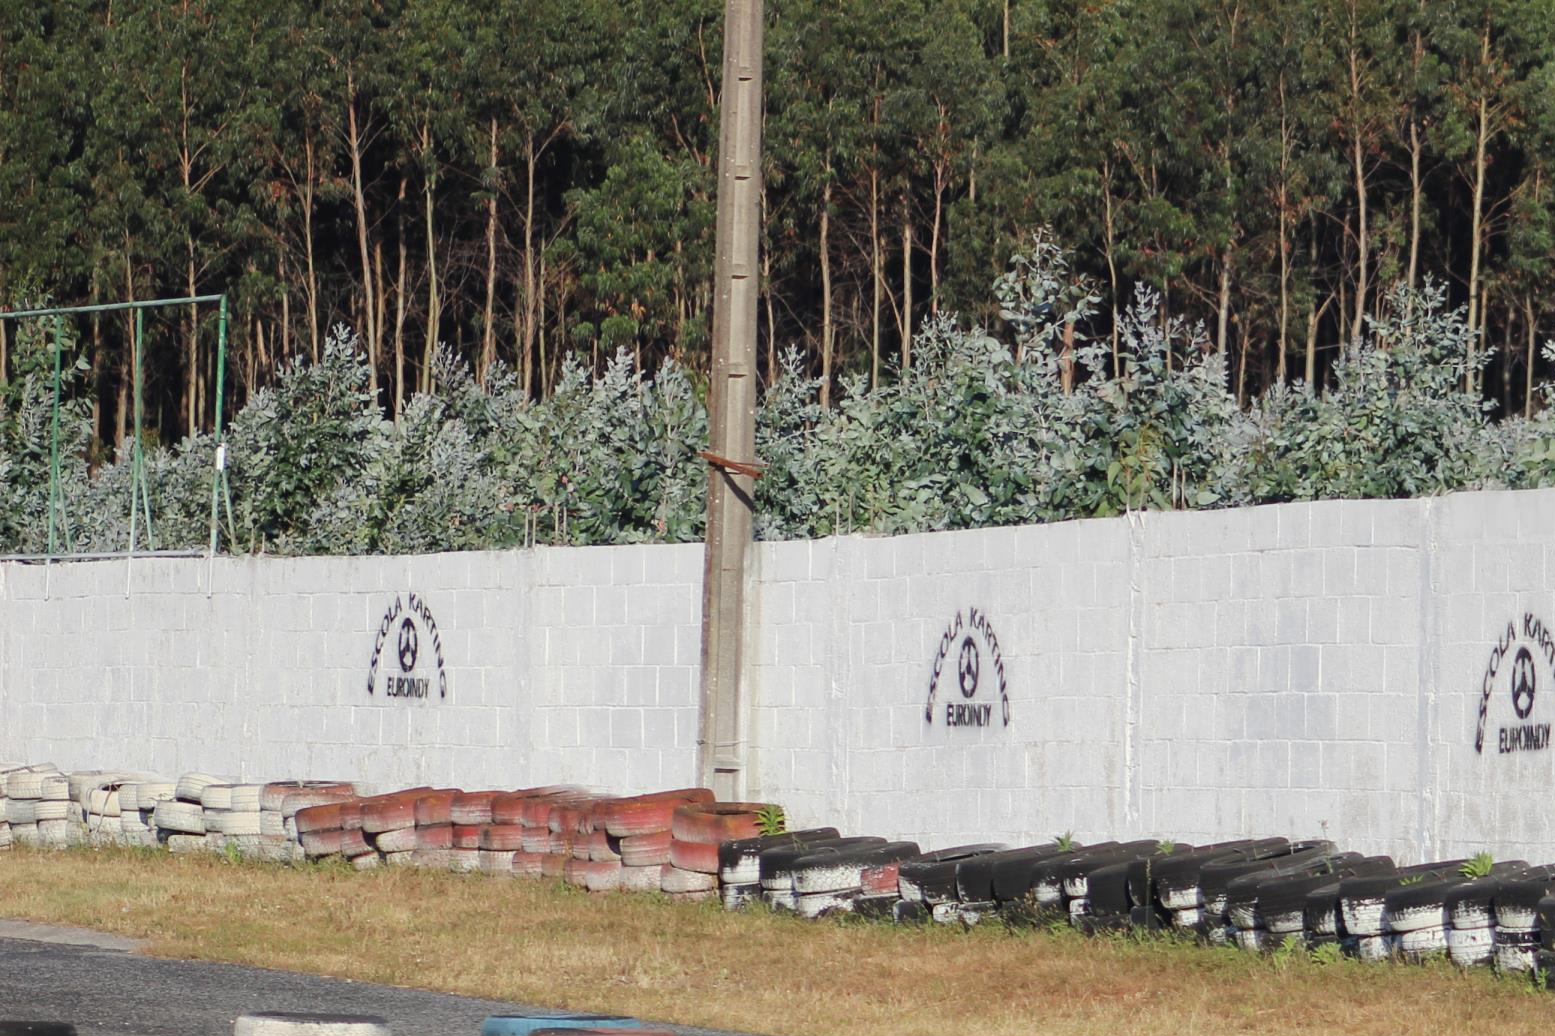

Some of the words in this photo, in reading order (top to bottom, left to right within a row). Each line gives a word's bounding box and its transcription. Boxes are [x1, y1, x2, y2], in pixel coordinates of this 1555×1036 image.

[386, 676, 431, 698] EUROINDY
[946, 703, 992, 727] EUROINDY
[1499, 723, 1551, 754] EUROINDY
